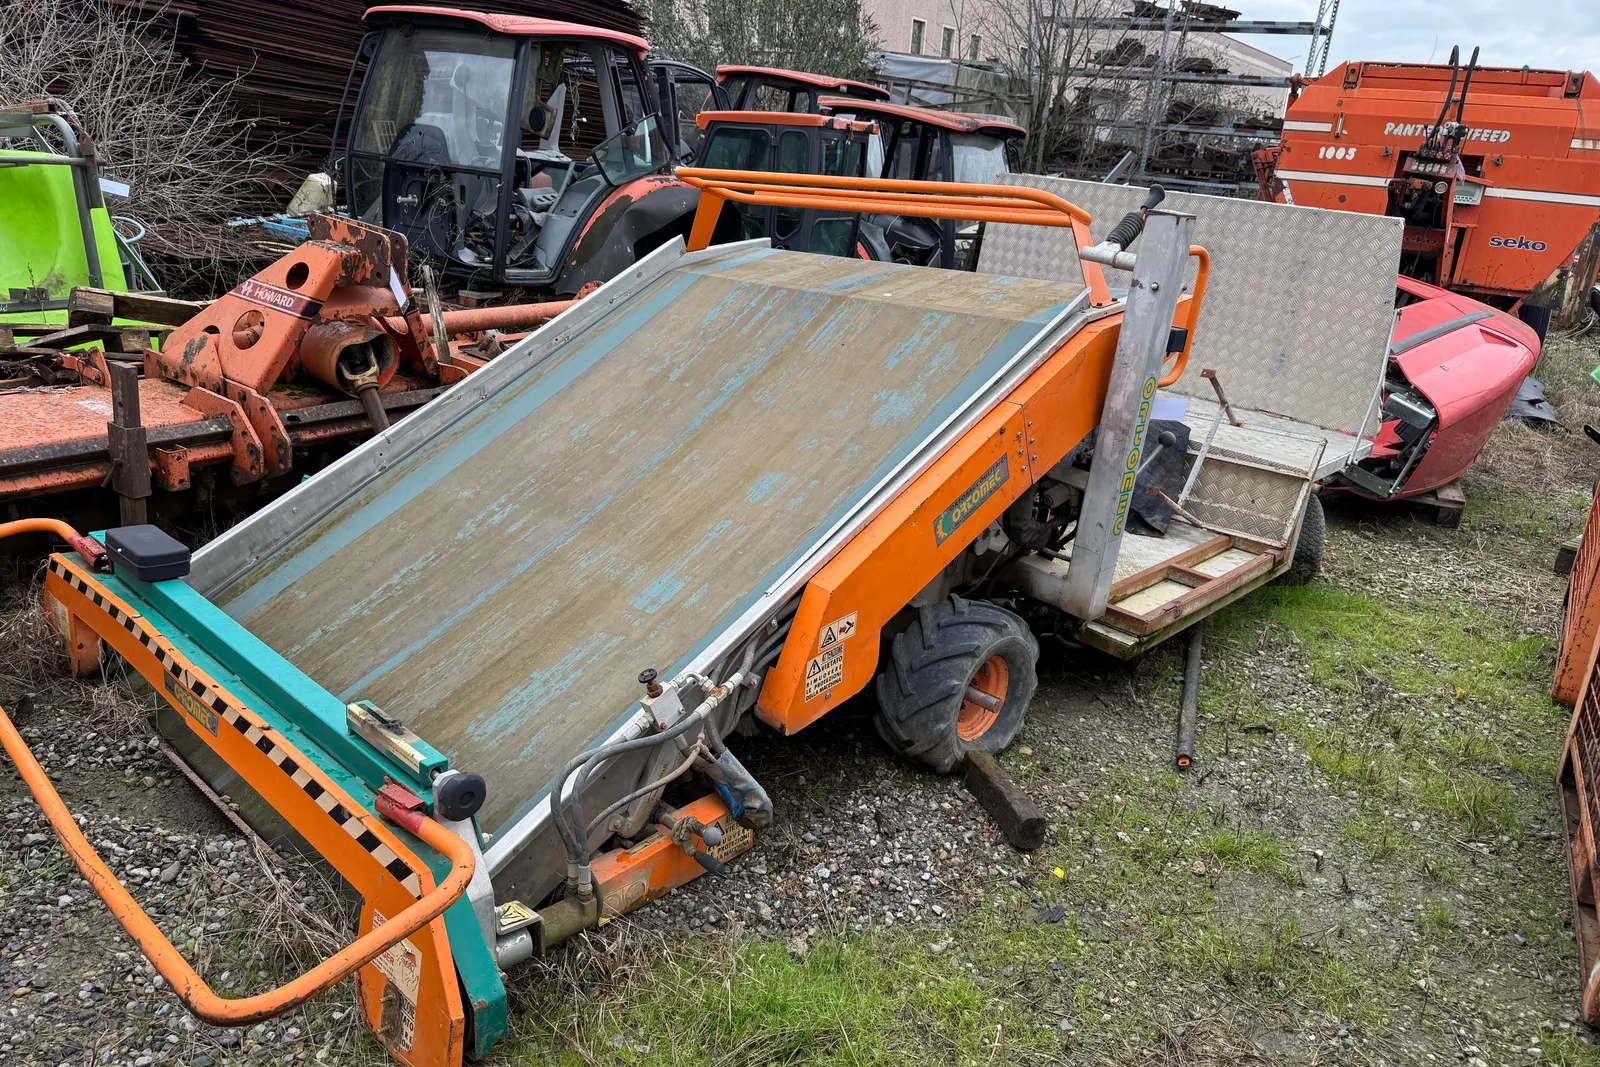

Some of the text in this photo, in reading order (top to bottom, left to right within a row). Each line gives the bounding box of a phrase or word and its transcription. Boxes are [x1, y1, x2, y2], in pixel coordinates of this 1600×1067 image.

[1318, 146, 1357, 160] 1005
[1403, 235, 1437, 245] eko
[1489, 235, 1547, 251] seko
[254, 286, 294, 308] HOWARD
[1113, 376, 1156, 537] ORTOMEC
[952, 469, 1001, 522] ORTOMEC
[821, 655, 843, 671] VIETATO
[806, 664, 842, 687] RIMUOVERE
[814, 671, 842, 690] PROTEZIONI
